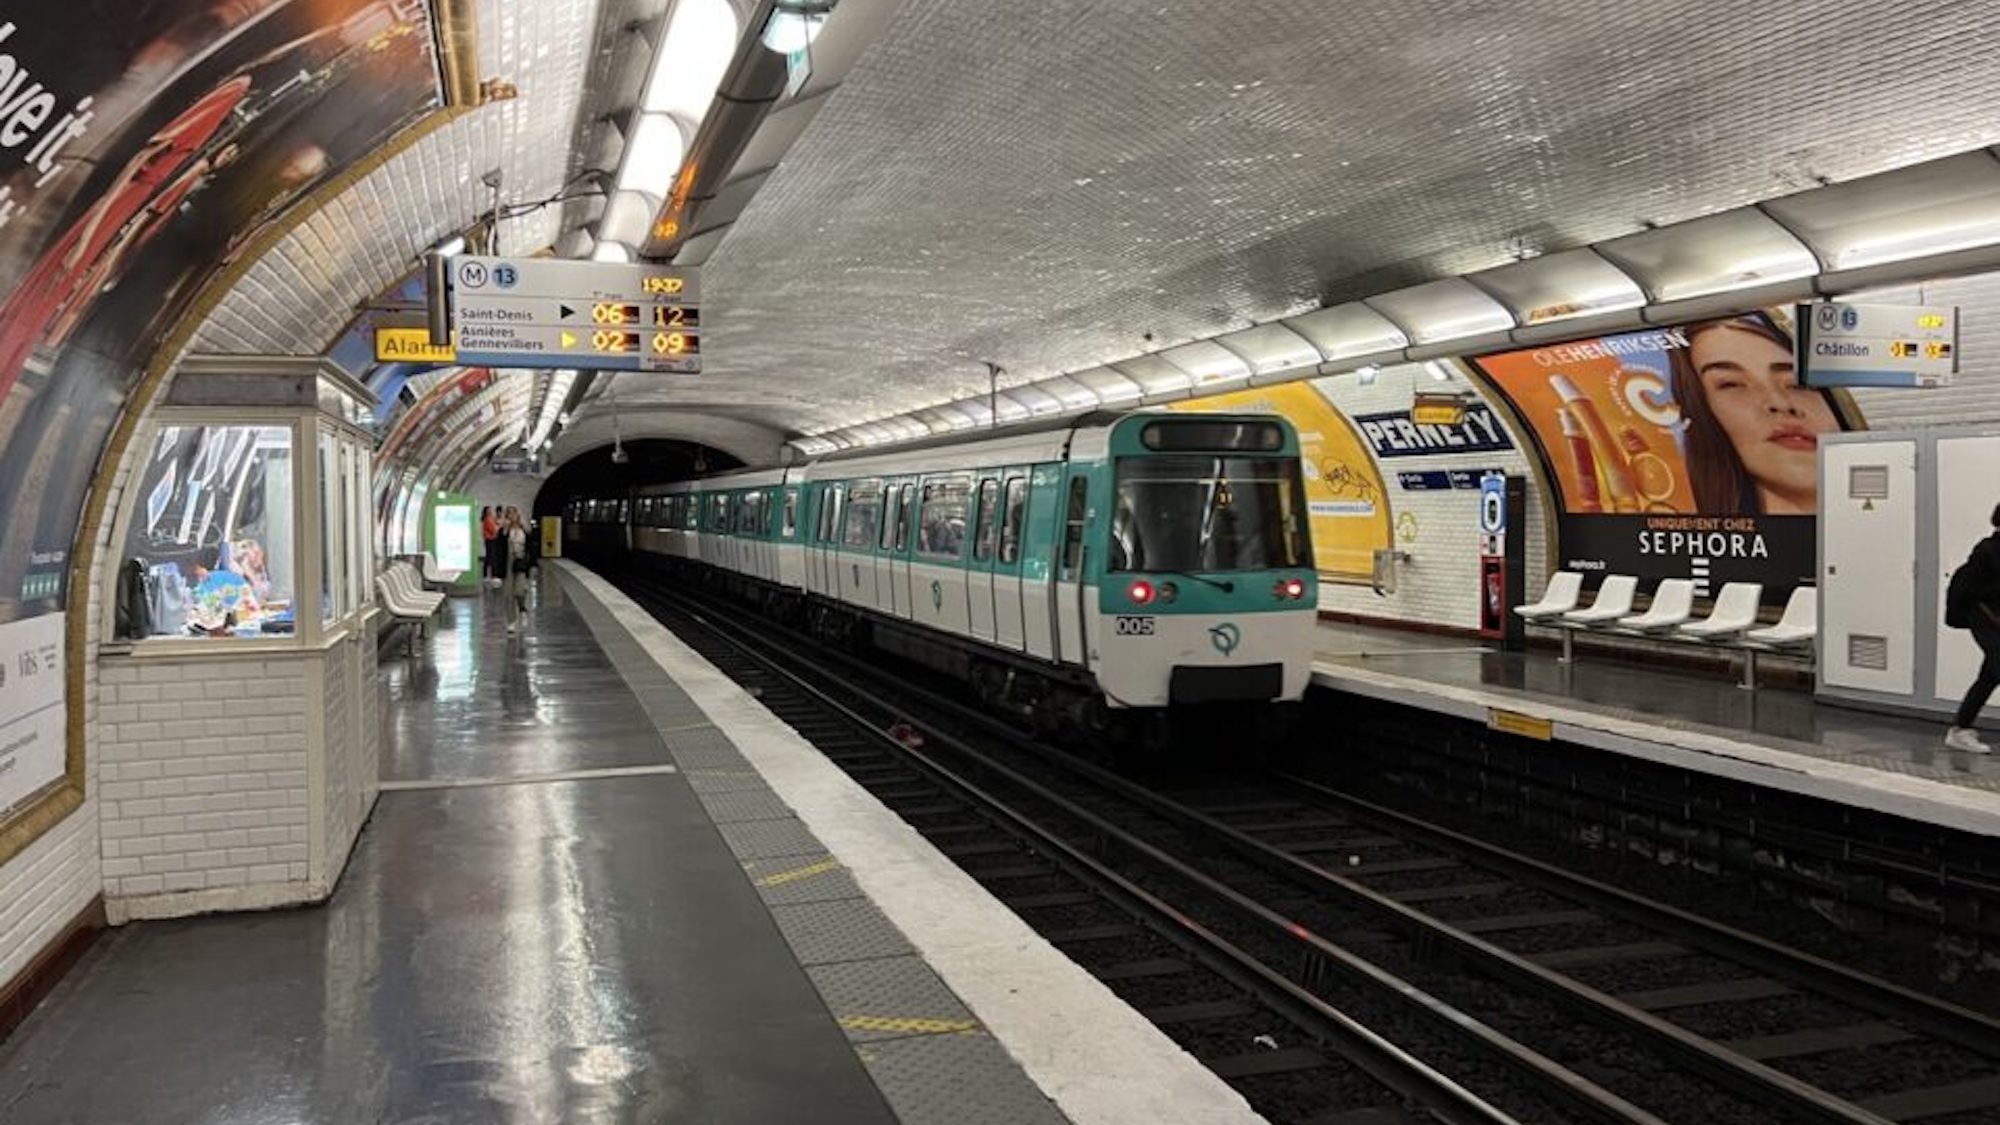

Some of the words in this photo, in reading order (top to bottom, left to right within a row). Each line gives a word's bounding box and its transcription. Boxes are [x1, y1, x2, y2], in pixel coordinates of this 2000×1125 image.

[494, 268, 515, 284] 13
[461, 308, 533, 321] Saint-Denis
[592, 303, 624, 324] 06
[655, 306, 683, 326] 12
[1844, 312, 1856, 327] 13
[461, 326, 515, 338] Asnières
[461, 338, 544, 350] Gennevilliers
[592, 331, 624, 351] 02
[653, 332, 684, 353] 09
[1816, 343, 1869, 357] Châtillon
[1360, 409, 1500, 450] PERNETY
[1724, 519, 1756, 531] CHEZ
[1638, 531, 1768, 557] SEPHORA
[1117, 617, 1153, 634] 005
